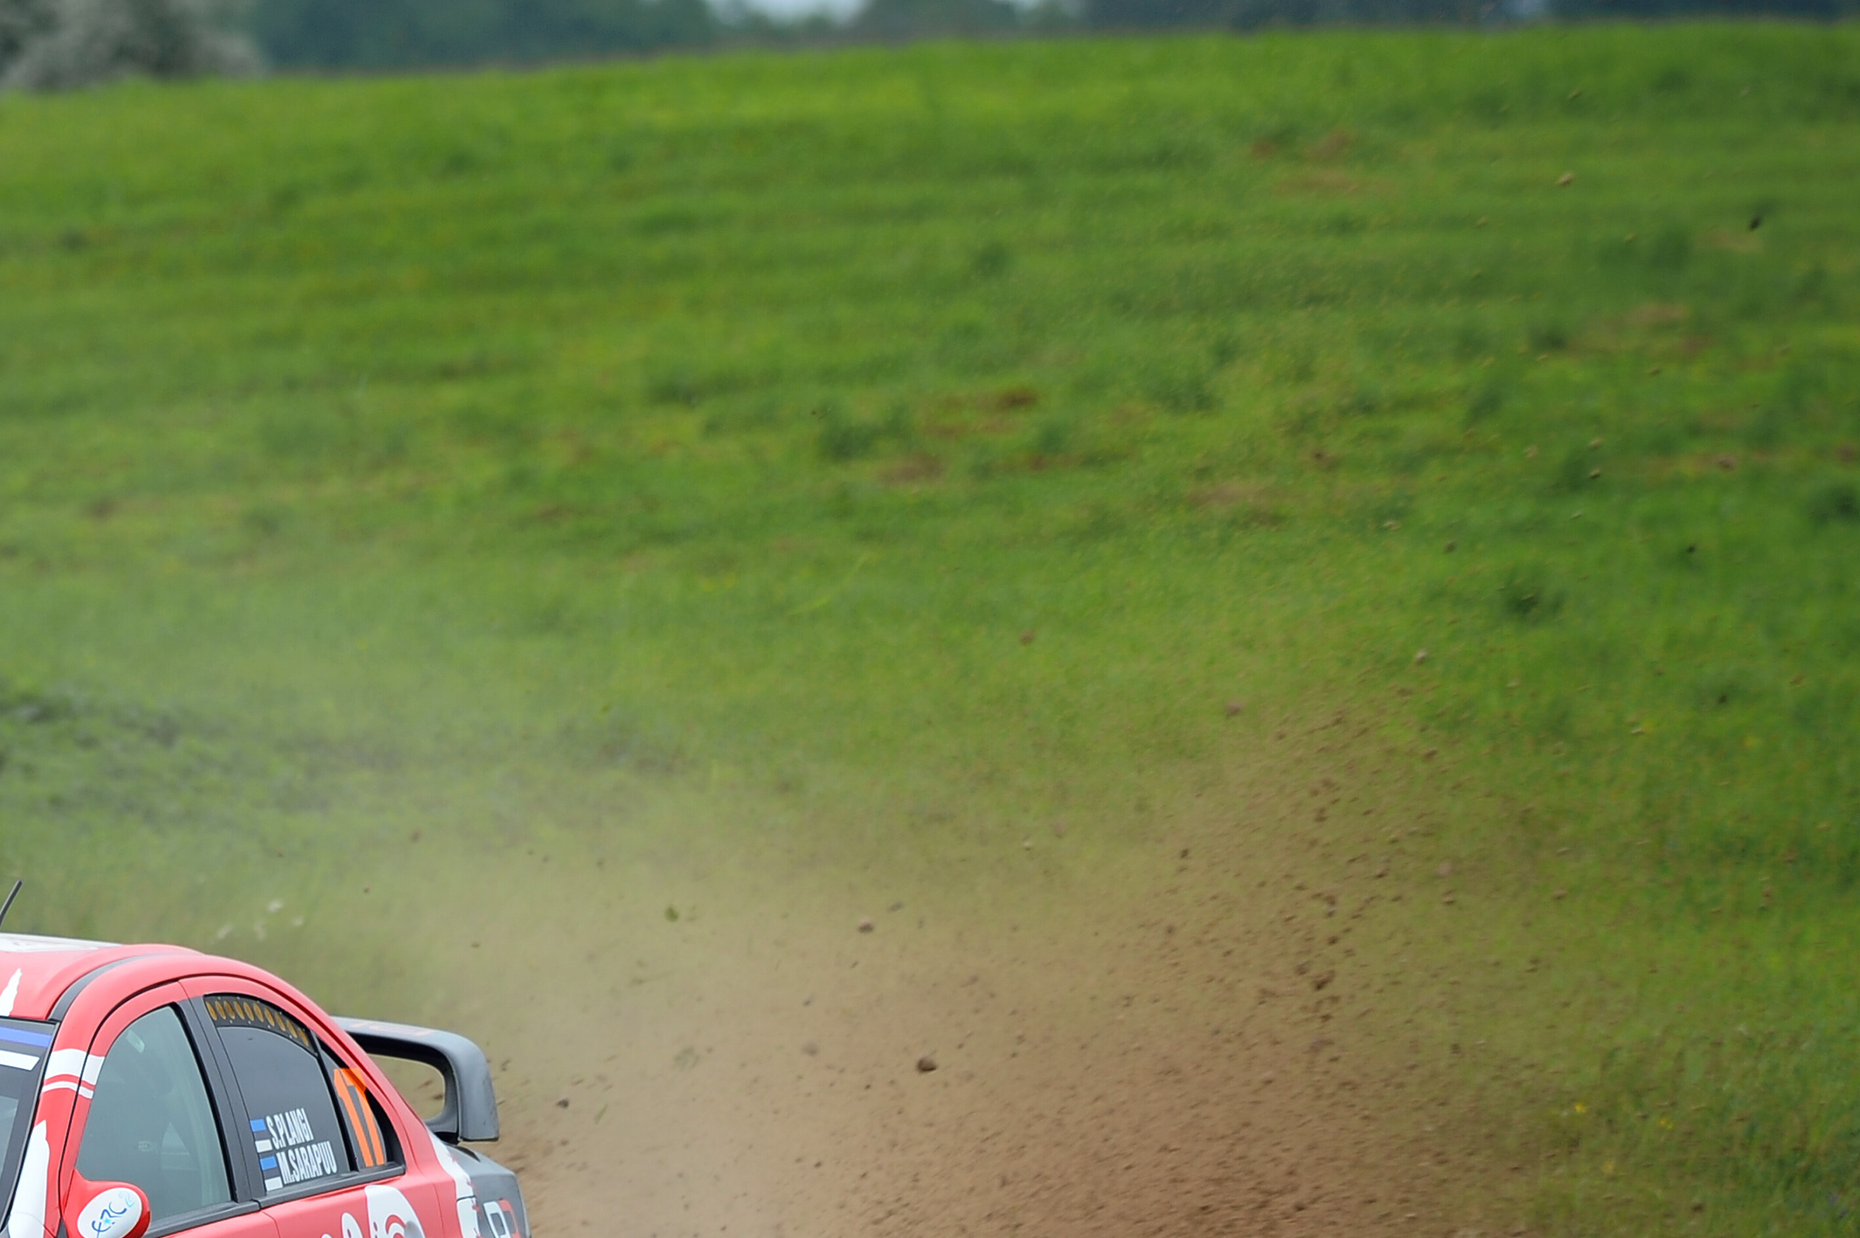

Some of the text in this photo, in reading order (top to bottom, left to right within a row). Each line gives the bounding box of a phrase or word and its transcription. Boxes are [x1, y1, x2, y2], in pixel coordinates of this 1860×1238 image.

[265, 1107, 314, 1150] S.PLANGI
[333, 1066, 385, 1168] 17
[276, 1140, 338, 1185] M.SARAPUU
